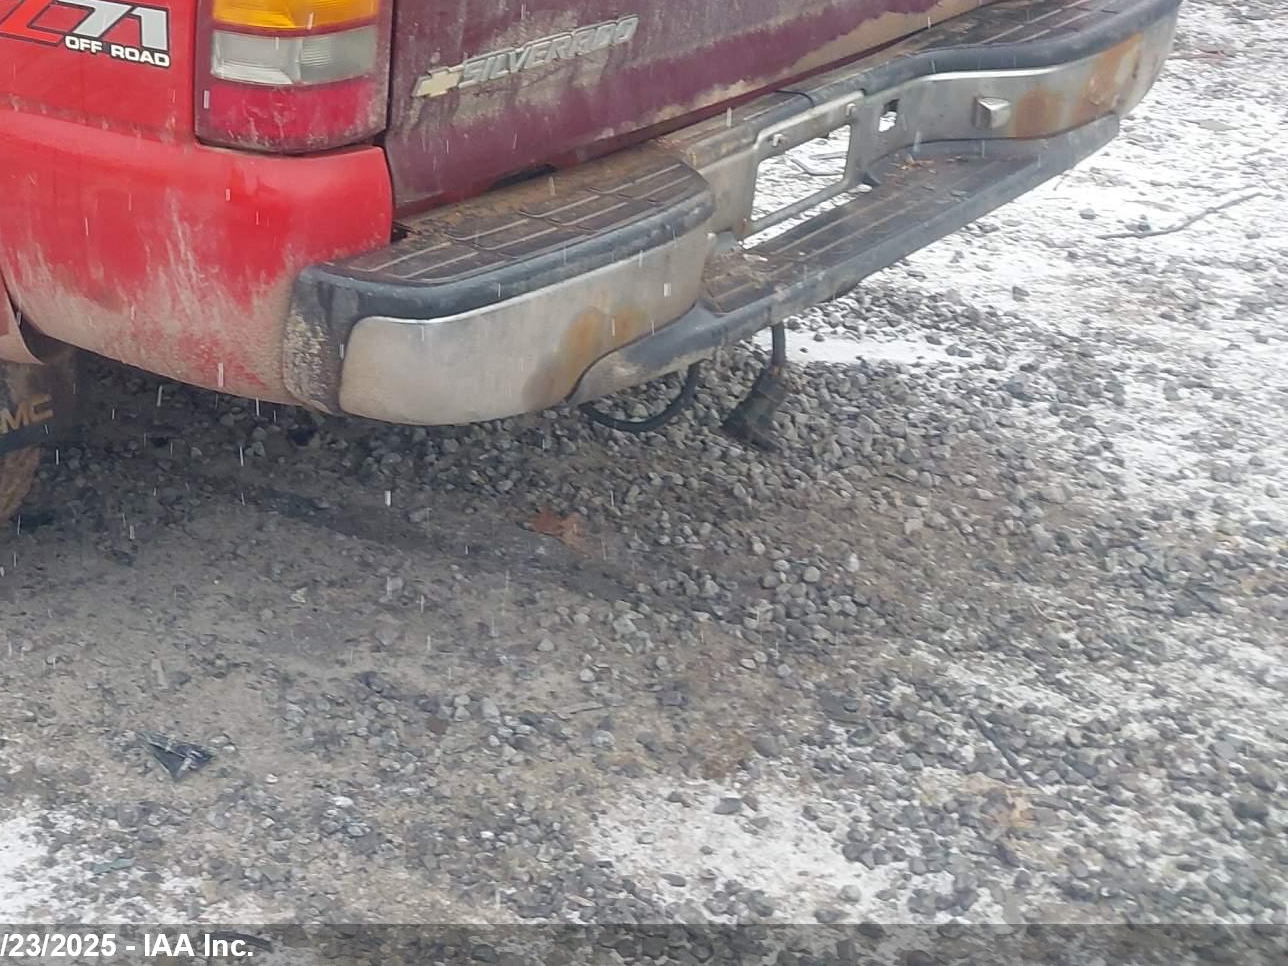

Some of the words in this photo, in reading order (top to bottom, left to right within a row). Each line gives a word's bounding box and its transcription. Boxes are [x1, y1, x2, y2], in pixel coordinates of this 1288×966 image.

[64, 35, 104, 54] OFF
[110, 44, 171, 68] ROAD
[458, 15, 640, 89] SILVERADO
